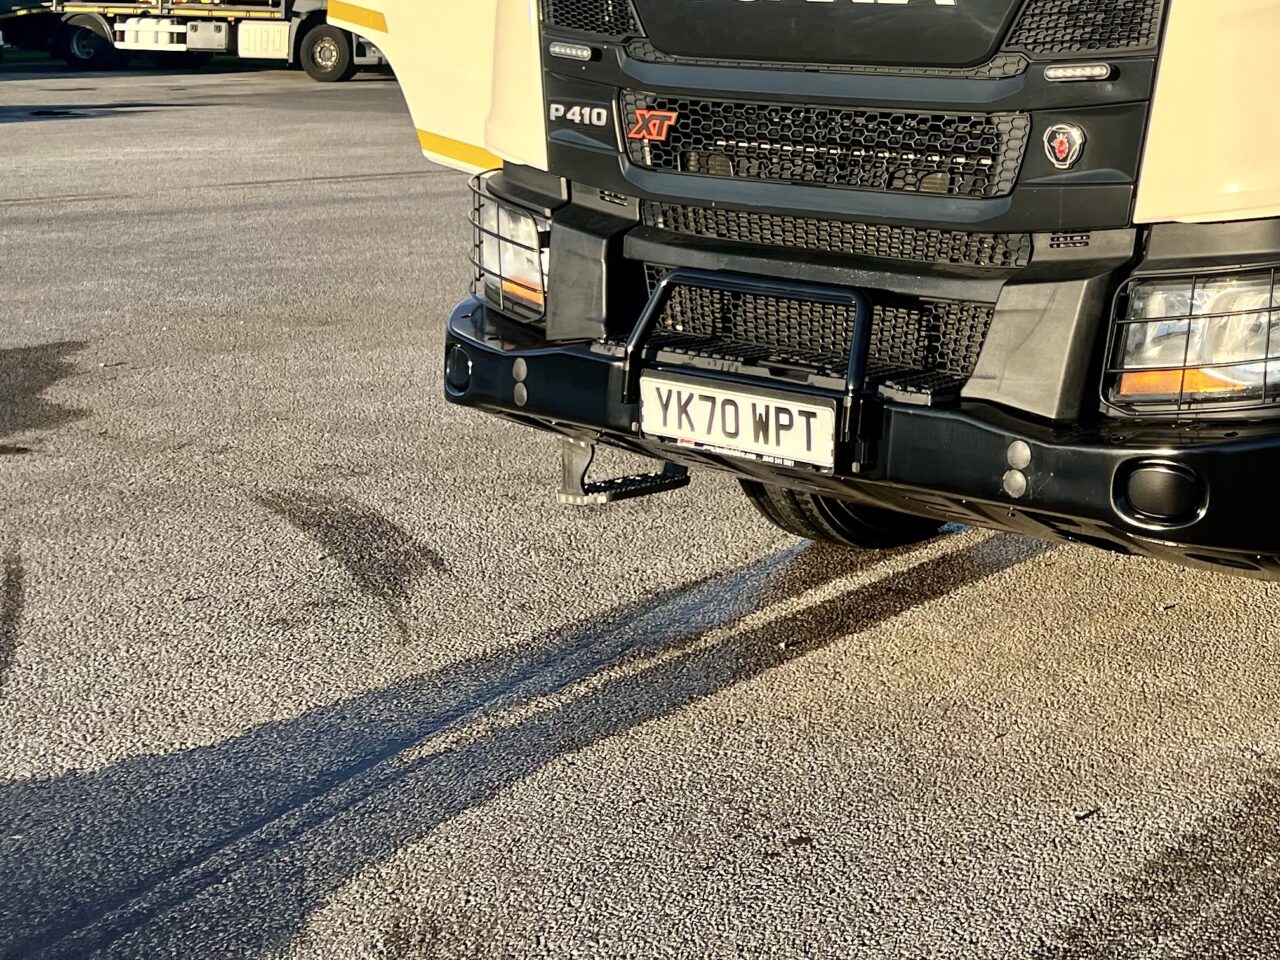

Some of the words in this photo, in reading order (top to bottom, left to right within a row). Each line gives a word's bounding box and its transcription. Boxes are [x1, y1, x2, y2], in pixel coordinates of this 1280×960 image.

[628, 109, 679, 141] XT
[655, 386, 740, 439] YK70
[751, 402, 818, 452] WPT
